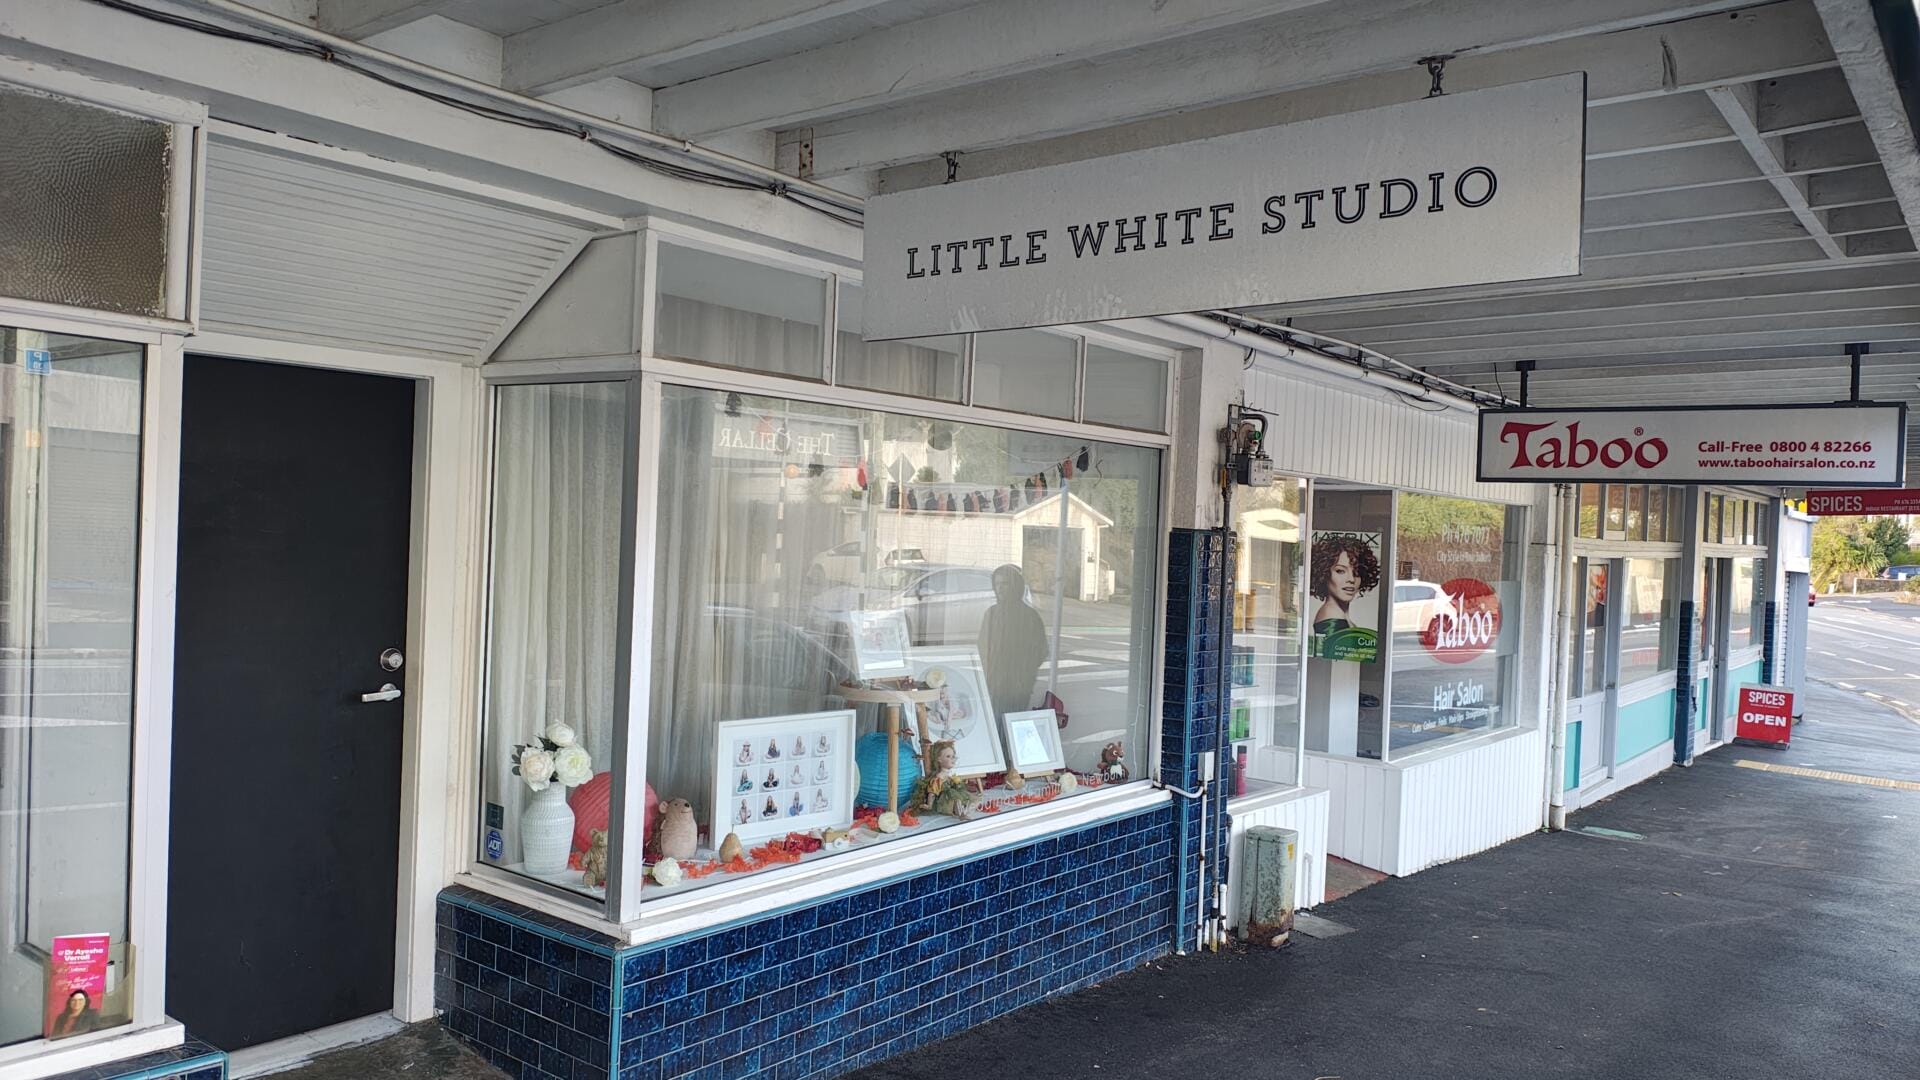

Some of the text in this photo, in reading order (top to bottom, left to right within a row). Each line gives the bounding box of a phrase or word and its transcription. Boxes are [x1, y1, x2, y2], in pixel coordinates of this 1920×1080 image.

[906, 166, 1498, 279] LITTLE WHITE STUDIO
[1500, 420, 1669, 469] Taboo
[1698, 441, 1872, 452] Call-Free 0800 4 82266
[1698, 457, 1876, 469] www.taboohairsalon.co.nz
[1810, 496, 1863, 512] SPICES
[1433, 591, 1493, 650] Taboo
[1433, 678, 1484, 712] Hair Salon
[1748, 691, 1786, 706] SPICES
[1742, 712, 1787, 727] OPEN
[1082, 767, 1127, 786] Newborn
[488, 839, 502, 852] ADT
